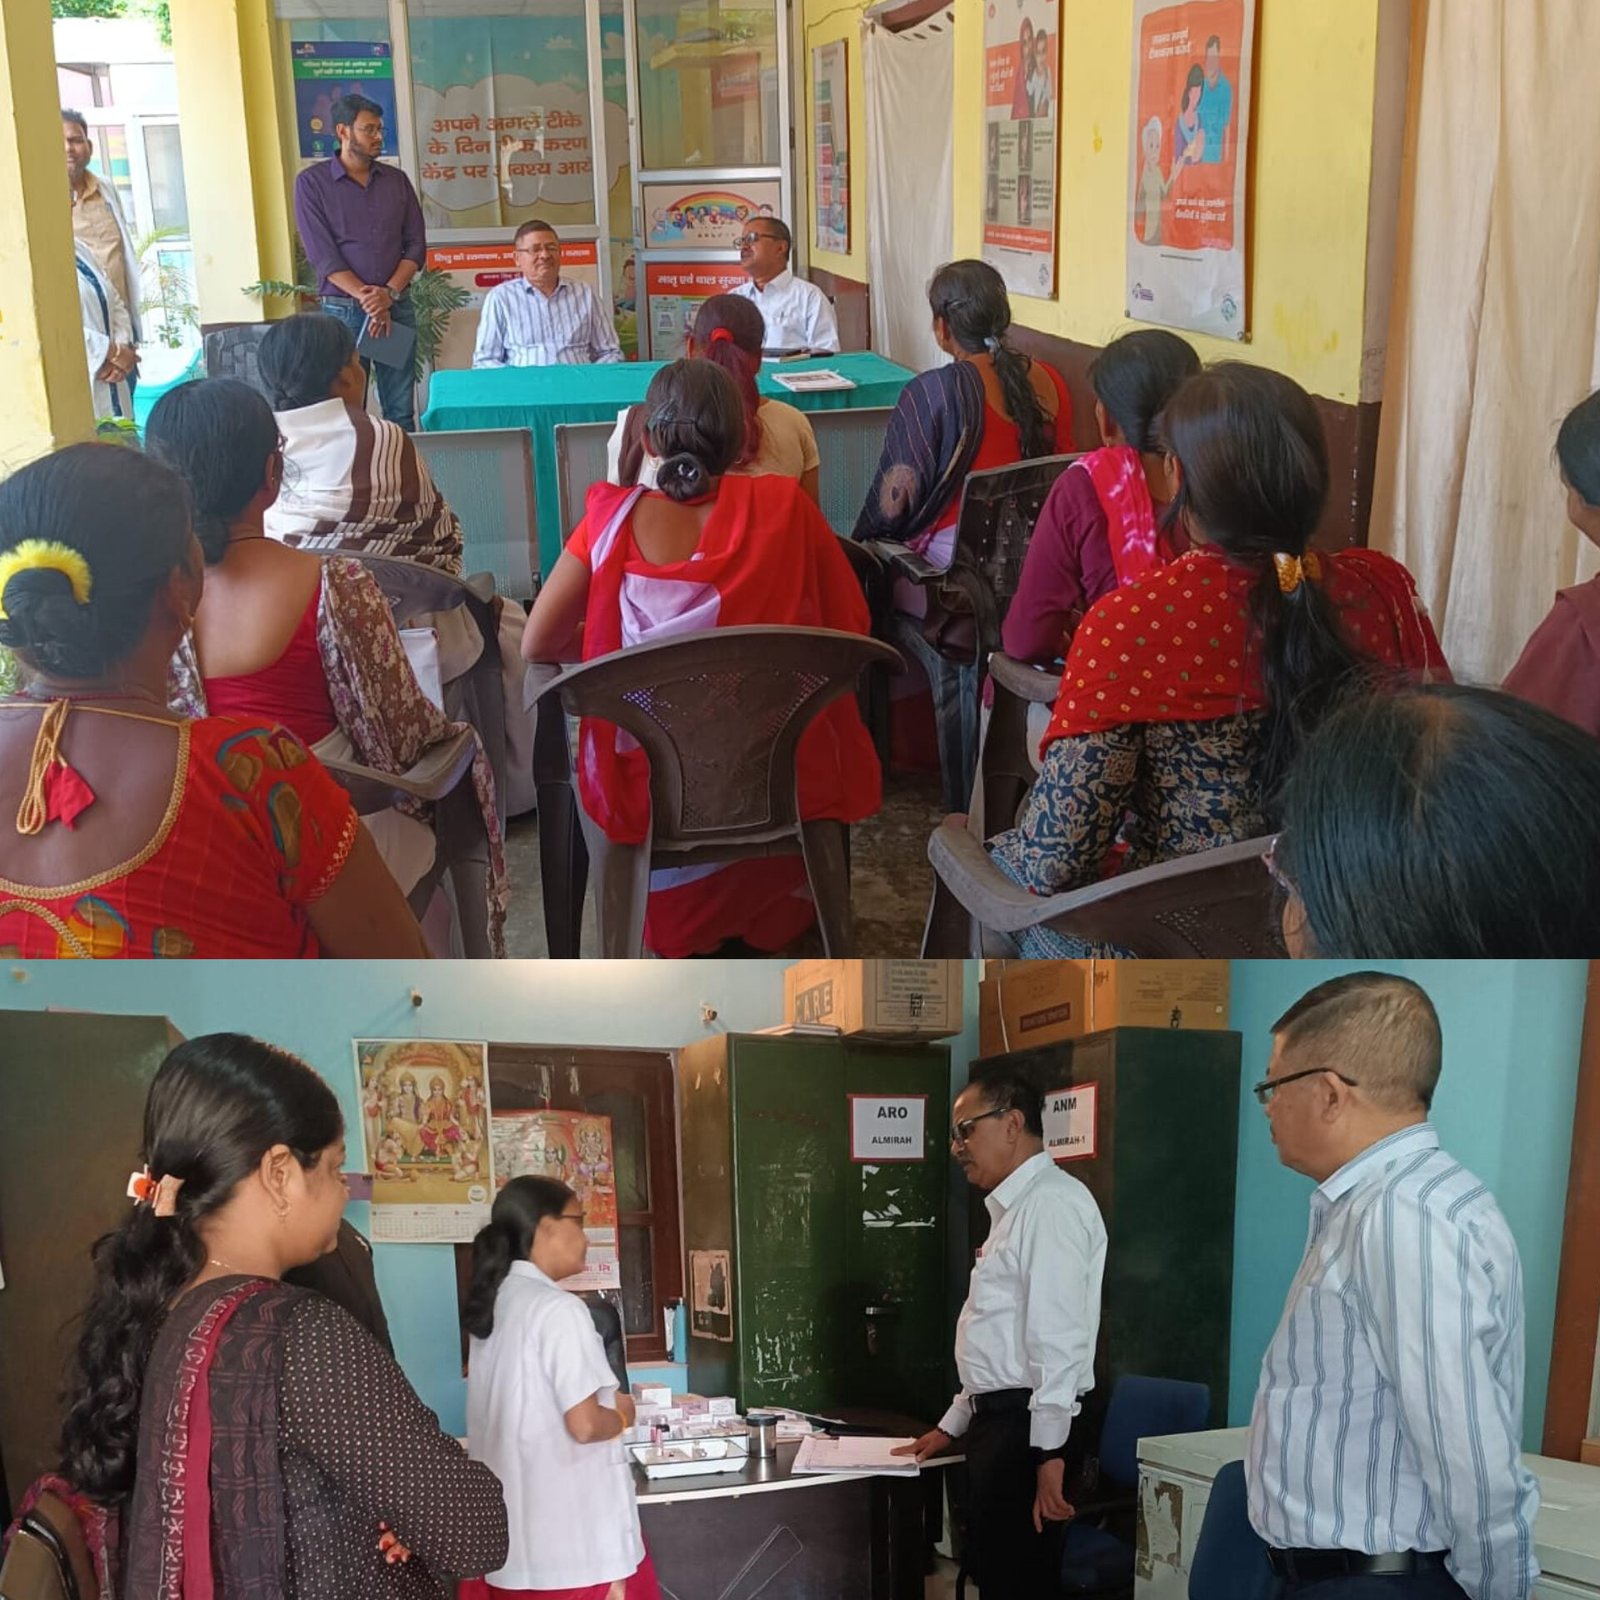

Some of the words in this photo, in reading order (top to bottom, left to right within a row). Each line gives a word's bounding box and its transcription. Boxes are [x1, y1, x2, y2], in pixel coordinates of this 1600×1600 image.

[432, 114, 480, 133] अपने
[486, 112, 540, 132] अगले
[545, 110, 583, 129] टीके
[427, 138, 448, 155] के
[455, 136, 491, 154] दिन
[421, 162, 456, 181] केंद्र
[462, 164, 489, 178] पर
[877, 1106, 908, 1119] ARO
[1053, 1096, 1077, 1113] ANM
[871, 1136, 912, 1145] ALMIRAH
[1048, 1135, 1086, 1147] ALMIRAH-1
